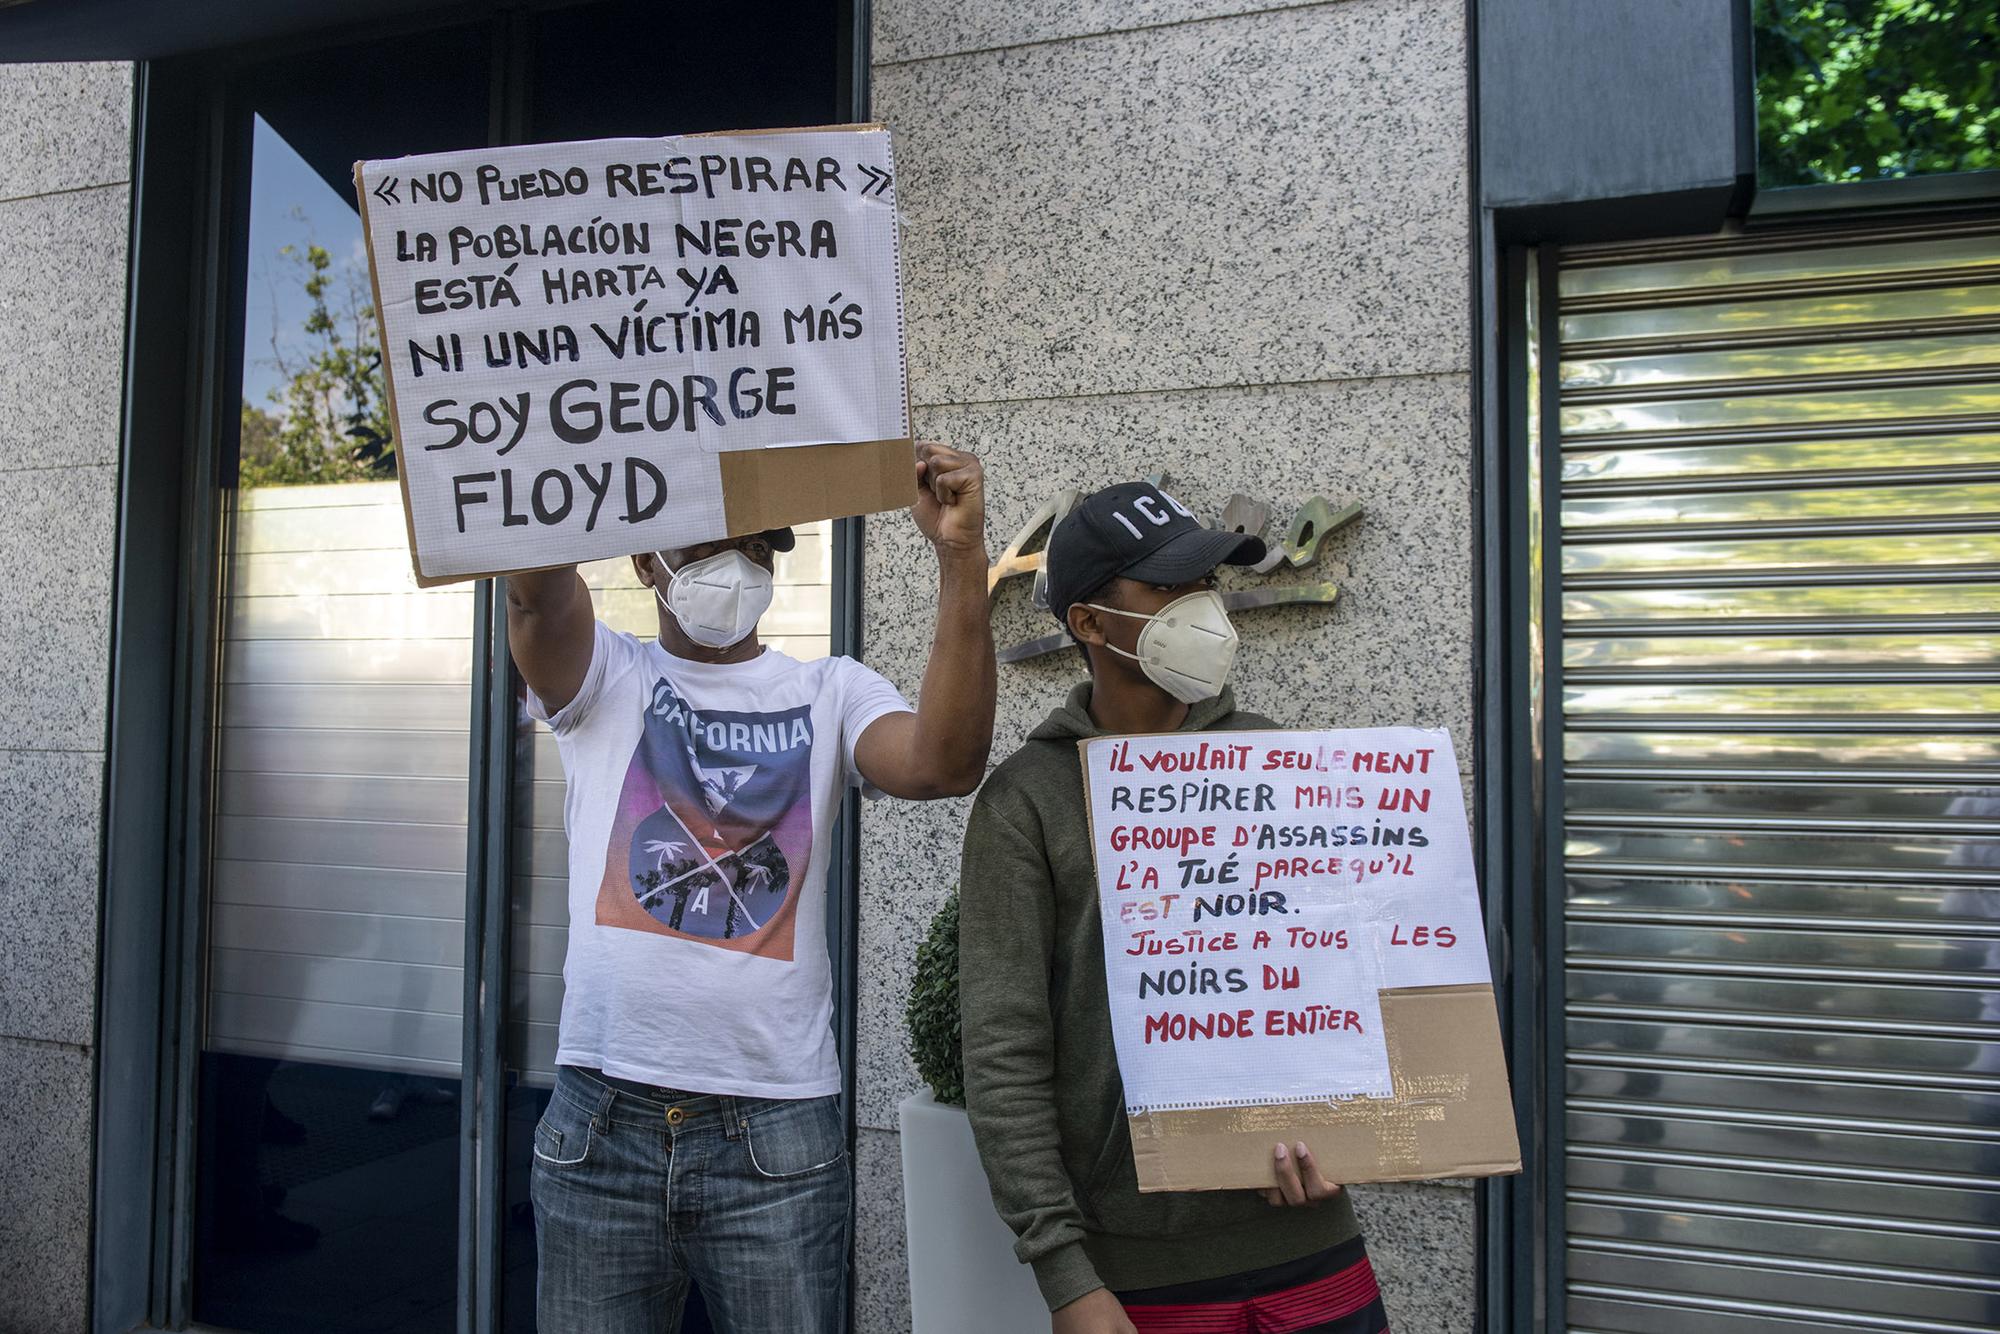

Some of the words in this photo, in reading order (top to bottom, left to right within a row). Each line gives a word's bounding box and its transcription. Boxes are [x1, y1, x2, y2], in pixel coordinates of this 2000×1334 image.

[475, 160, 590, 207] PUEDO
[394, 226, 438, 264] LA
[674, 216, 838, 260] NEGRA
[414, 261, 522, 316] ESTÁ
[543, 263, 667, 306] HARTA
[675, 264, 740, 307] YA
[408, 333, 464, 378] NI
[482, 323, 581, 370] UNA
[589, 297, 762, 362] VÍCTIMA
[782, 290, 865, 346] MÁS
[421, 391, 532, 457] SOY
[547, 365, 798, 446] GEORGE
[452, 455, 668, 534] FLOYD
[1108, 740, 1135, 773] IL
[1261, 745, 1436, 775] SEULEMENT
[1110, 776, 1276, 813] RESPIRER
[1294, 785, 1365, 811] MAIS
[1377, 787, 1432, 813] UN
[1109, 824, 1217, 858] GROUPE
[1115, 859, 1159, 891] L'A
[1176, 851, 1241, 889] TUÉ
[690, 887, 710, 915] A
[1119, 893, 1181, 925] EST
[1125, 928, 1238, 957] JUSTICE
[1251, 928, 1273, 951] A
[1286, 925, 1350, 951] TOUS
[1390, 923, 1458, 949] LES
[1138, 960, 1249, 1000] NOIRS
[1262, 965, 1301, 992] DU
[1144, 1008, 1255, 1045] MONDE
[1265, 1003, 1365, 1038] ENTIER
